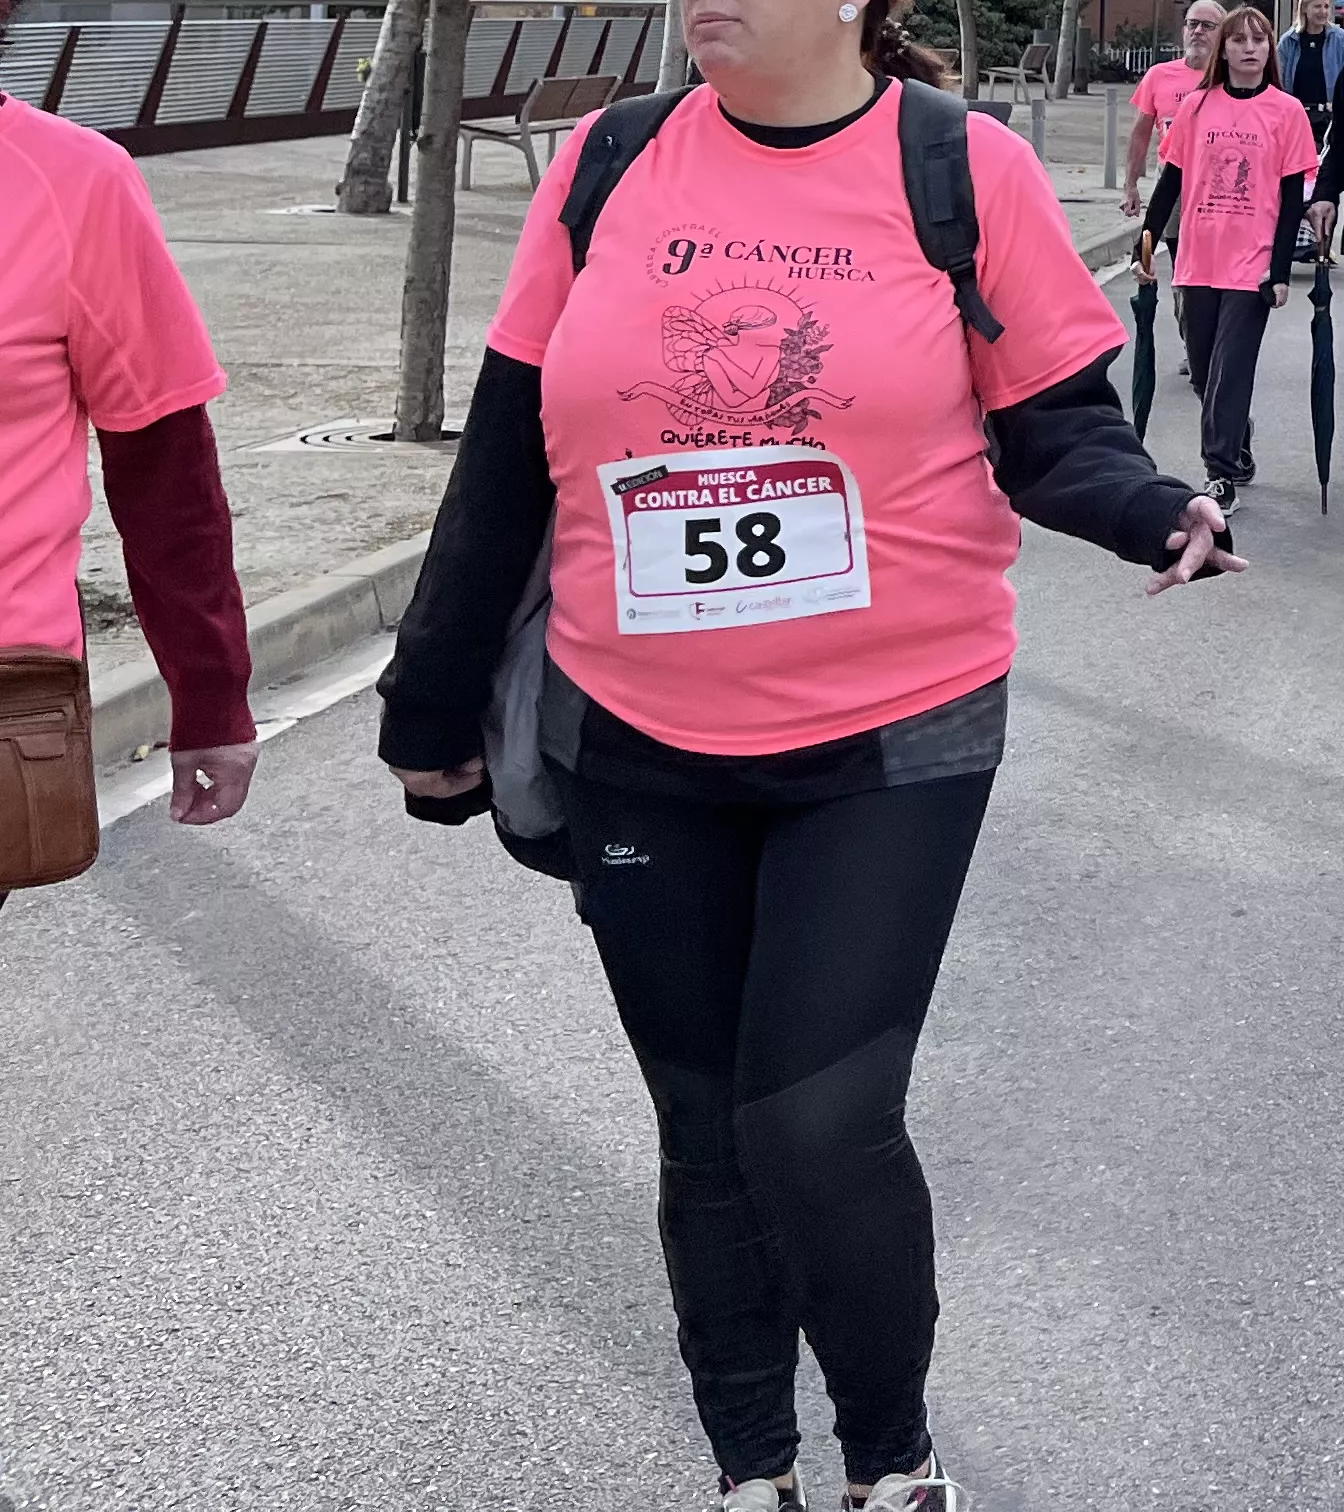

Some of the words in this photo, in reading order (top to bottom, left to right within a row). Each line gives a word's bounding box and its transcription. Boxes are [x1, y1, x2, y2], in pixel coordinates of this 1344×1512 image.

[662, 239, 714, 275] 9ª
[724, 239, 853, 266] CÁNCER
[788, 266, 876, 282] HUESCA
[634, 489, 713, 509] CONTRA
[719, 487, 741, 504] EL
[746, 476, 833, 500] CÁNCER
[698, 470, 757, 486] HUESCA
[685, 512, 786, 584] 58
